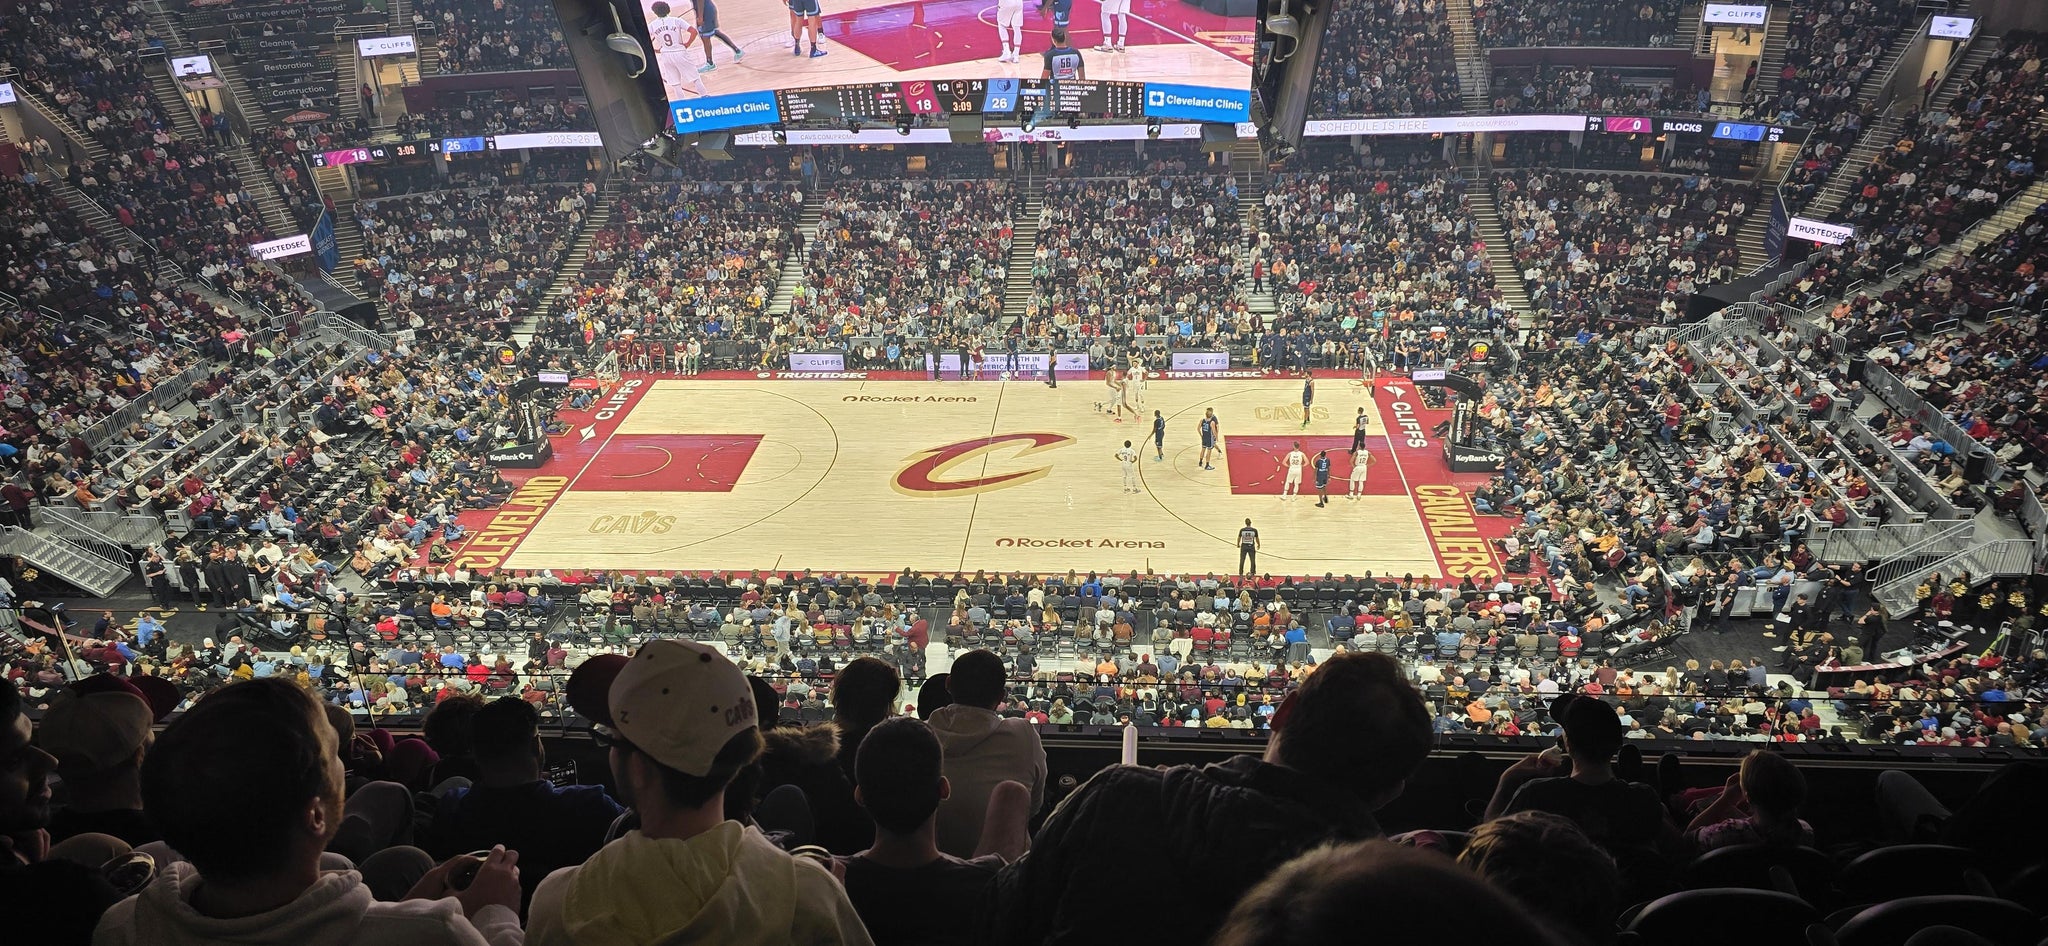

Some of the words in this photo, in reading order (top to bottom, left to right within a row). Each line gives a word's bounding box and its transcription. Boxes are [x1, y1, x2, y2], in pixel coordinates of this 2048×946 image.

[380, 41, 411, 49] CLIFFS
[663, 33, 673, 47] 9
[264, 61, 315, 72] Restoration.
[272, 85, 327, 97] Construction.
[937, 83, 949, 91] 1Q
[972, 81, 983, 91] 24
[916, 99, 932, 110] 18
[953, 101, 972, 111] 3:09
[992, 98, 1007, 109] 26
[1166, 94, 1214, 108] Cleveland
[1215, 98, 1243, 110] Clinic
[695, 104, 742, 118] Cleveland
[743, 102, 771, 113] Clinic
[1320, 121, 1379, 132] SCHEDULE
[1382, 121, 1395, 131] IS
[1399, 120, 1429, 130] HERE
[1589, 123, 1600, 131] 31
[1632, 120, 1642, 130] 0
[1663, 122, 1703, 132] BLOCKS
[1722, 126, 1731, 136] 0
[546, 134, 591, 145] 2025-26
[1768, 134, 1779, 142] 53
[396, 145, 416, 156] 3:09
[429, 143, 440, 152] 24
[446, 140, 461, 151] 26
[488, 142, 494, 150] 5
[352, 150, 367, 161] 18
[372, 149, 384, 157] 1Q
[595, 379, 642, 420] CLIFFS
[860, 395, 920, 403] Rocket
[923, 395, 977, 403] Arena
[1392, 402, 1428, 448] CLIFFS
[490, 454, 519, 462] KeyBank
[1455, 454, 1488, 462] KeyBank
[455, 476, 569, 569] CLEVELAND
[588, 511, 677, 534] CAVS
[1415, 485, 1498, 578] CAVALIERS
[1017, 538, 1094, 548] Rocket
[1098, 538, 1165, 548] Arena
